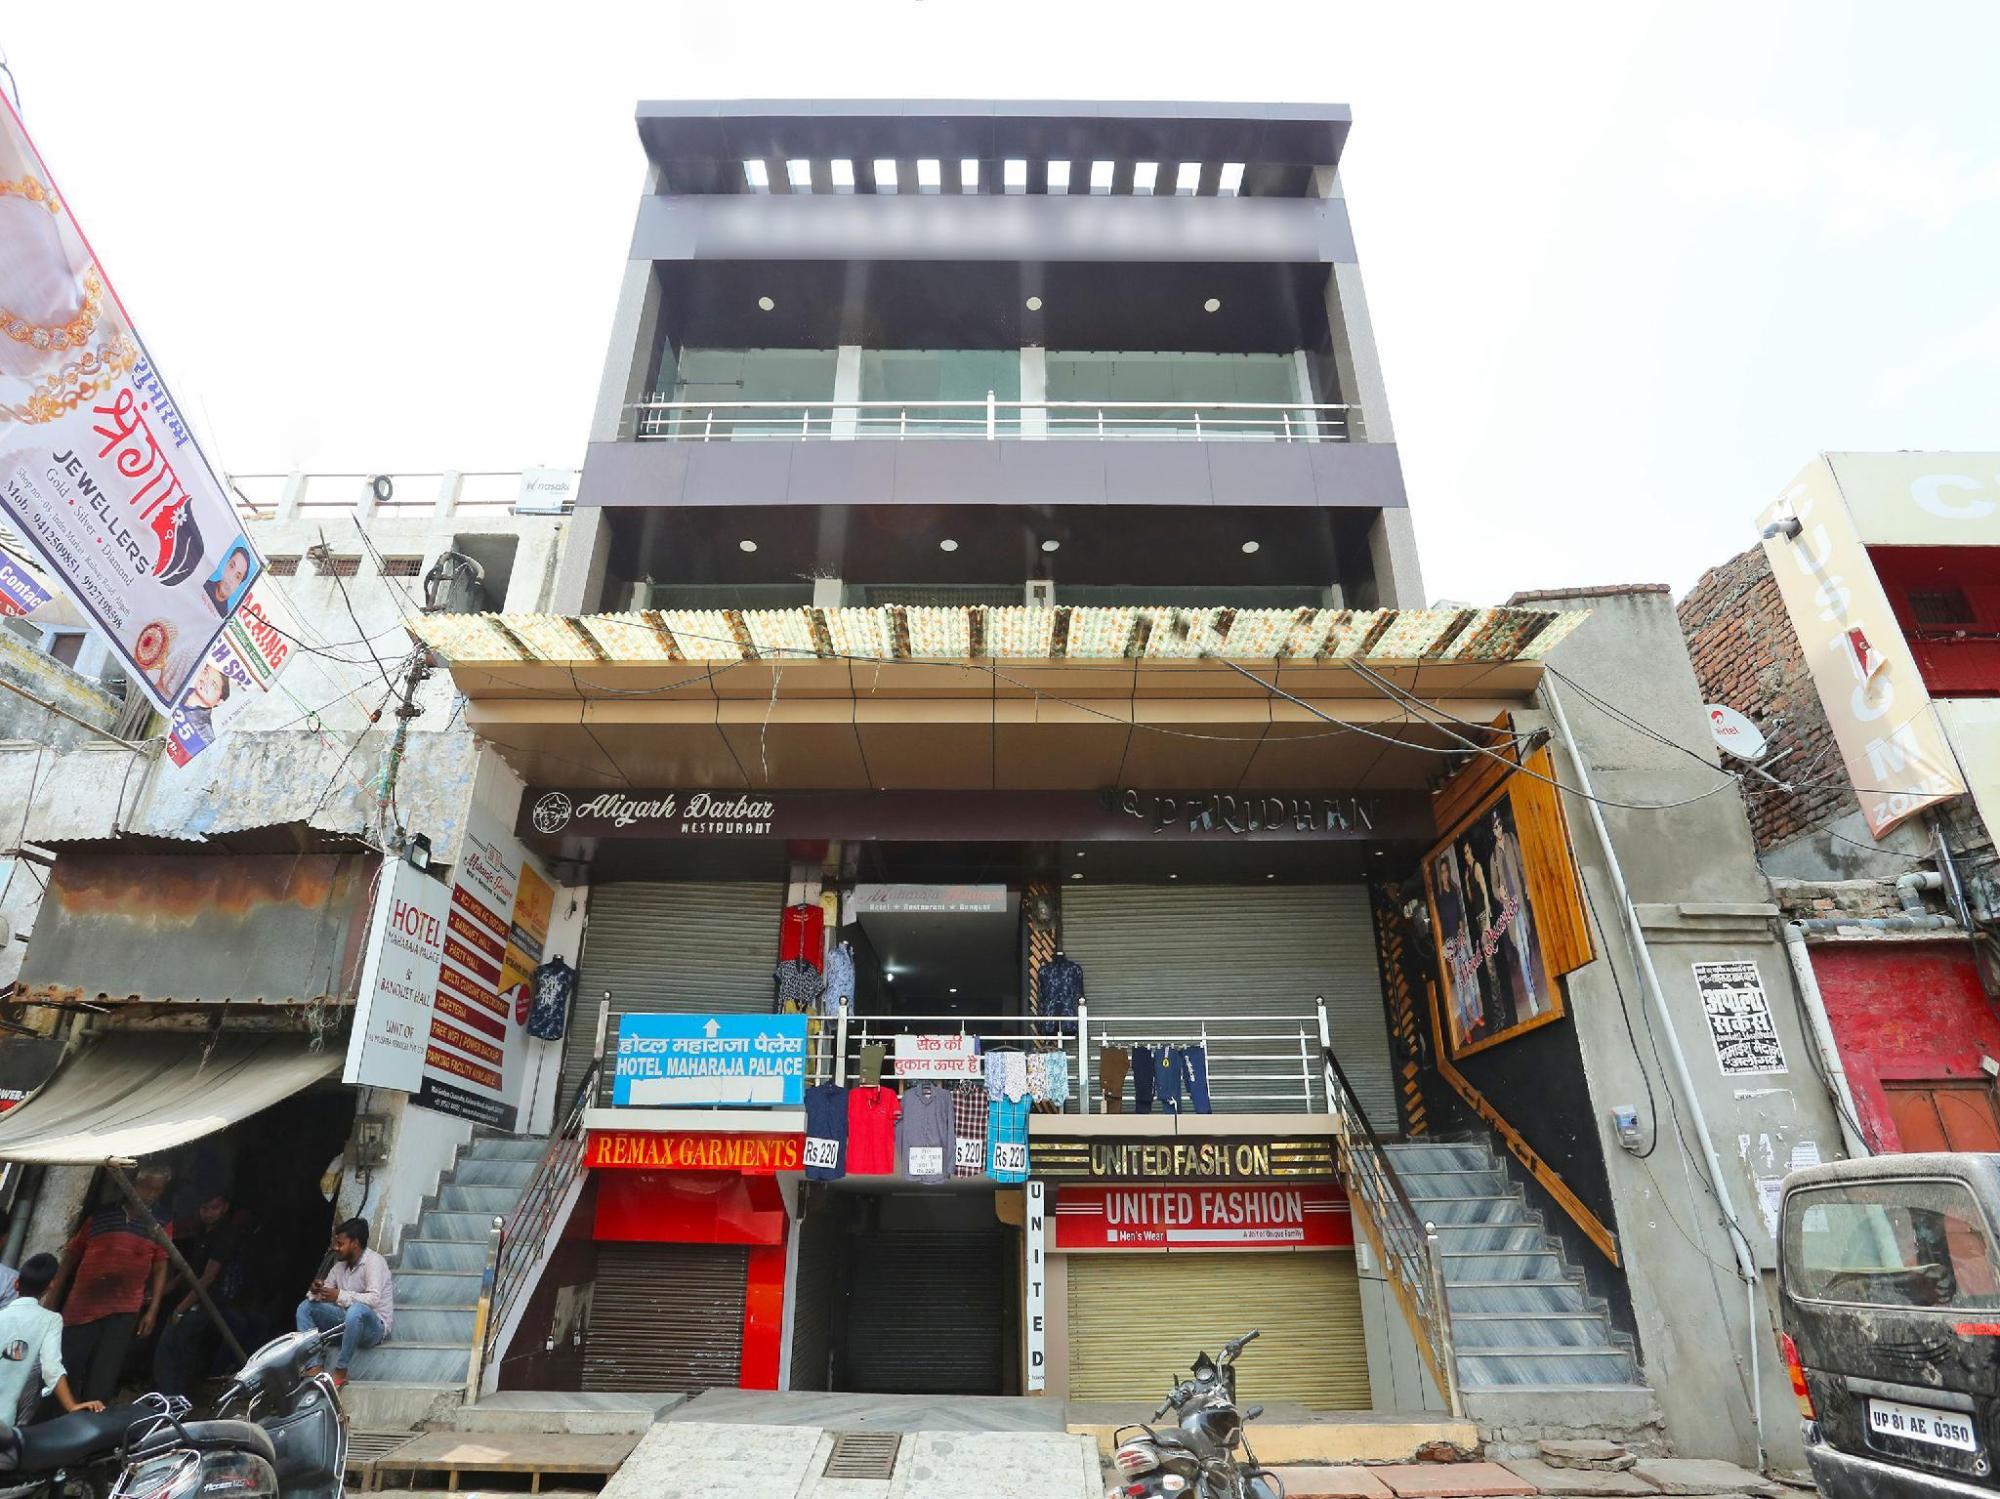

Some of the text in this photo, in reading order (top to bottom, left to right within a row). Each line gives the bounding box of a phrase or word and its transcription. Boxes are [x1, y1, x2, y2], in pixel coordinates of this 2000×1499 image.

[52, 449, 149, 576] JEWELLERS
[46, 467, 135, 588] Gold Silver Diamond
[575, 792, 775, 828] Aligarh Darbar
[392, 899, 441, 948] HOTEL
[672, 1038, 750, 1055] महाराजा
[754, 1032, 803, 1053] पैलेस
[916, 1034, 964, 1051] सेल की
[617, 1057, 803, 1076] HOTEL MAHARAJA PALACE
[895, 1058, 930, 1076] दुकान
[597, 1136, 798, 1168] REMAX GARMENTS
[806, 1141, 836, 1165] Rs 220
[964, 1144, 981, 1164] 220
[995, 1145, 1025, 1168] Rs 220
[1105, 1191, 1304, 1225] UNITED FASHION
[1119, 1230, 1164, 1241] Men's Wear
[1873, 1411, 1969, 1443] UP 81 AE 0350
